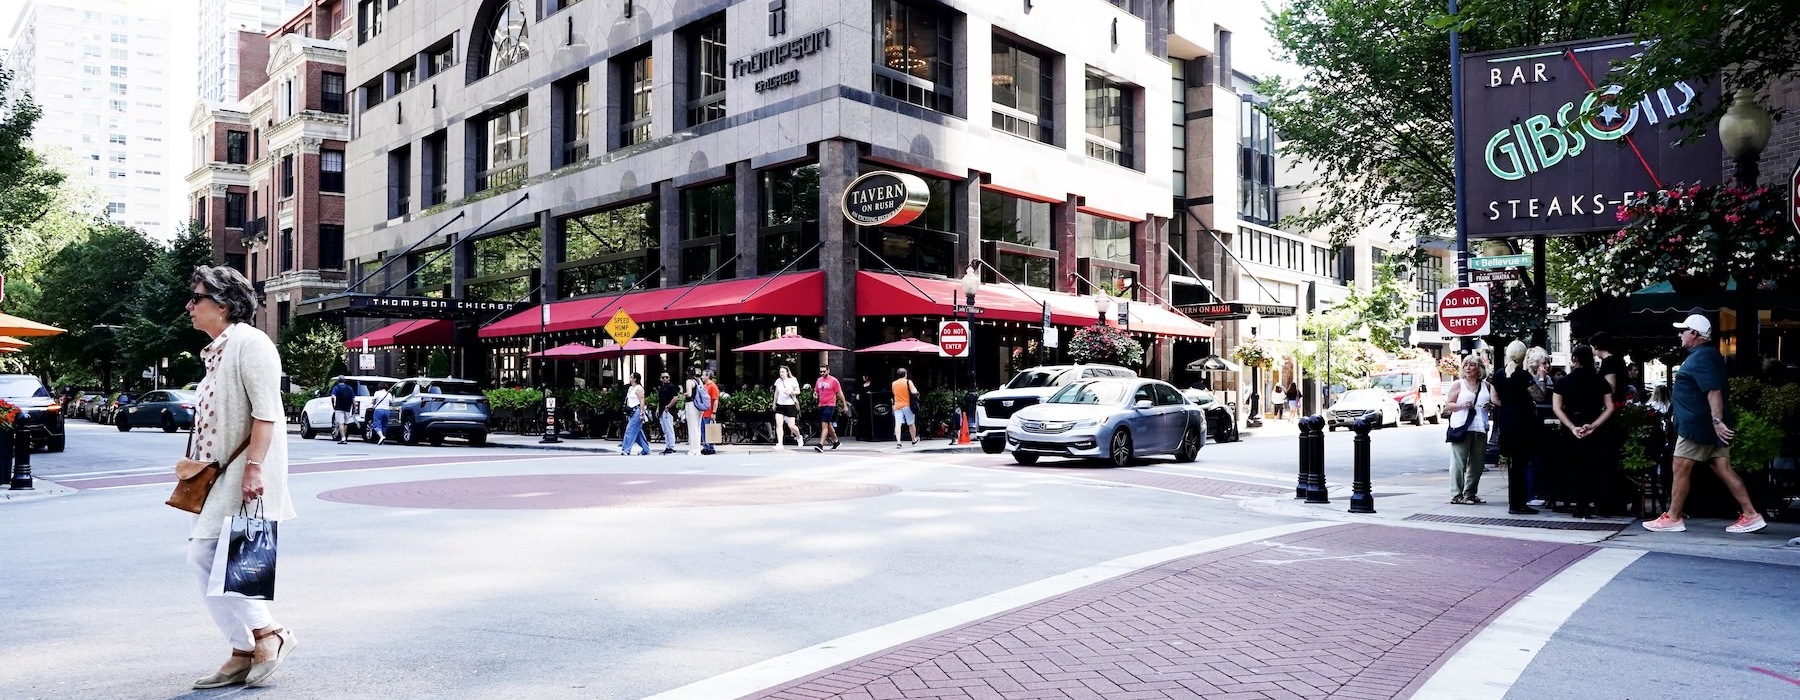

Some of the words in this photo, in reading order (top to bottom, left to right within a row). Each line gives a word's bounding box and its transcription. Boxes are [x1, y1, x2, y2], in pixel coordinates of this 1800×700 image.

[1490, 63, 1548, 87] BAR
[852, 183, 904, 204] TAVERN
[862, 203, 873, 212] ON
[875, 200, 894, 211] RUSH
[1481, 259, 1520, 267] Bellevue
[1445, 298, 1457, 306] DO
[1462, 296, 1480, 305] NOT
[1199, 305, 1210, 313] ON
[1211, 304, 1231, 312] RUSH
[1449, 318, 1478, 327] ENTER
